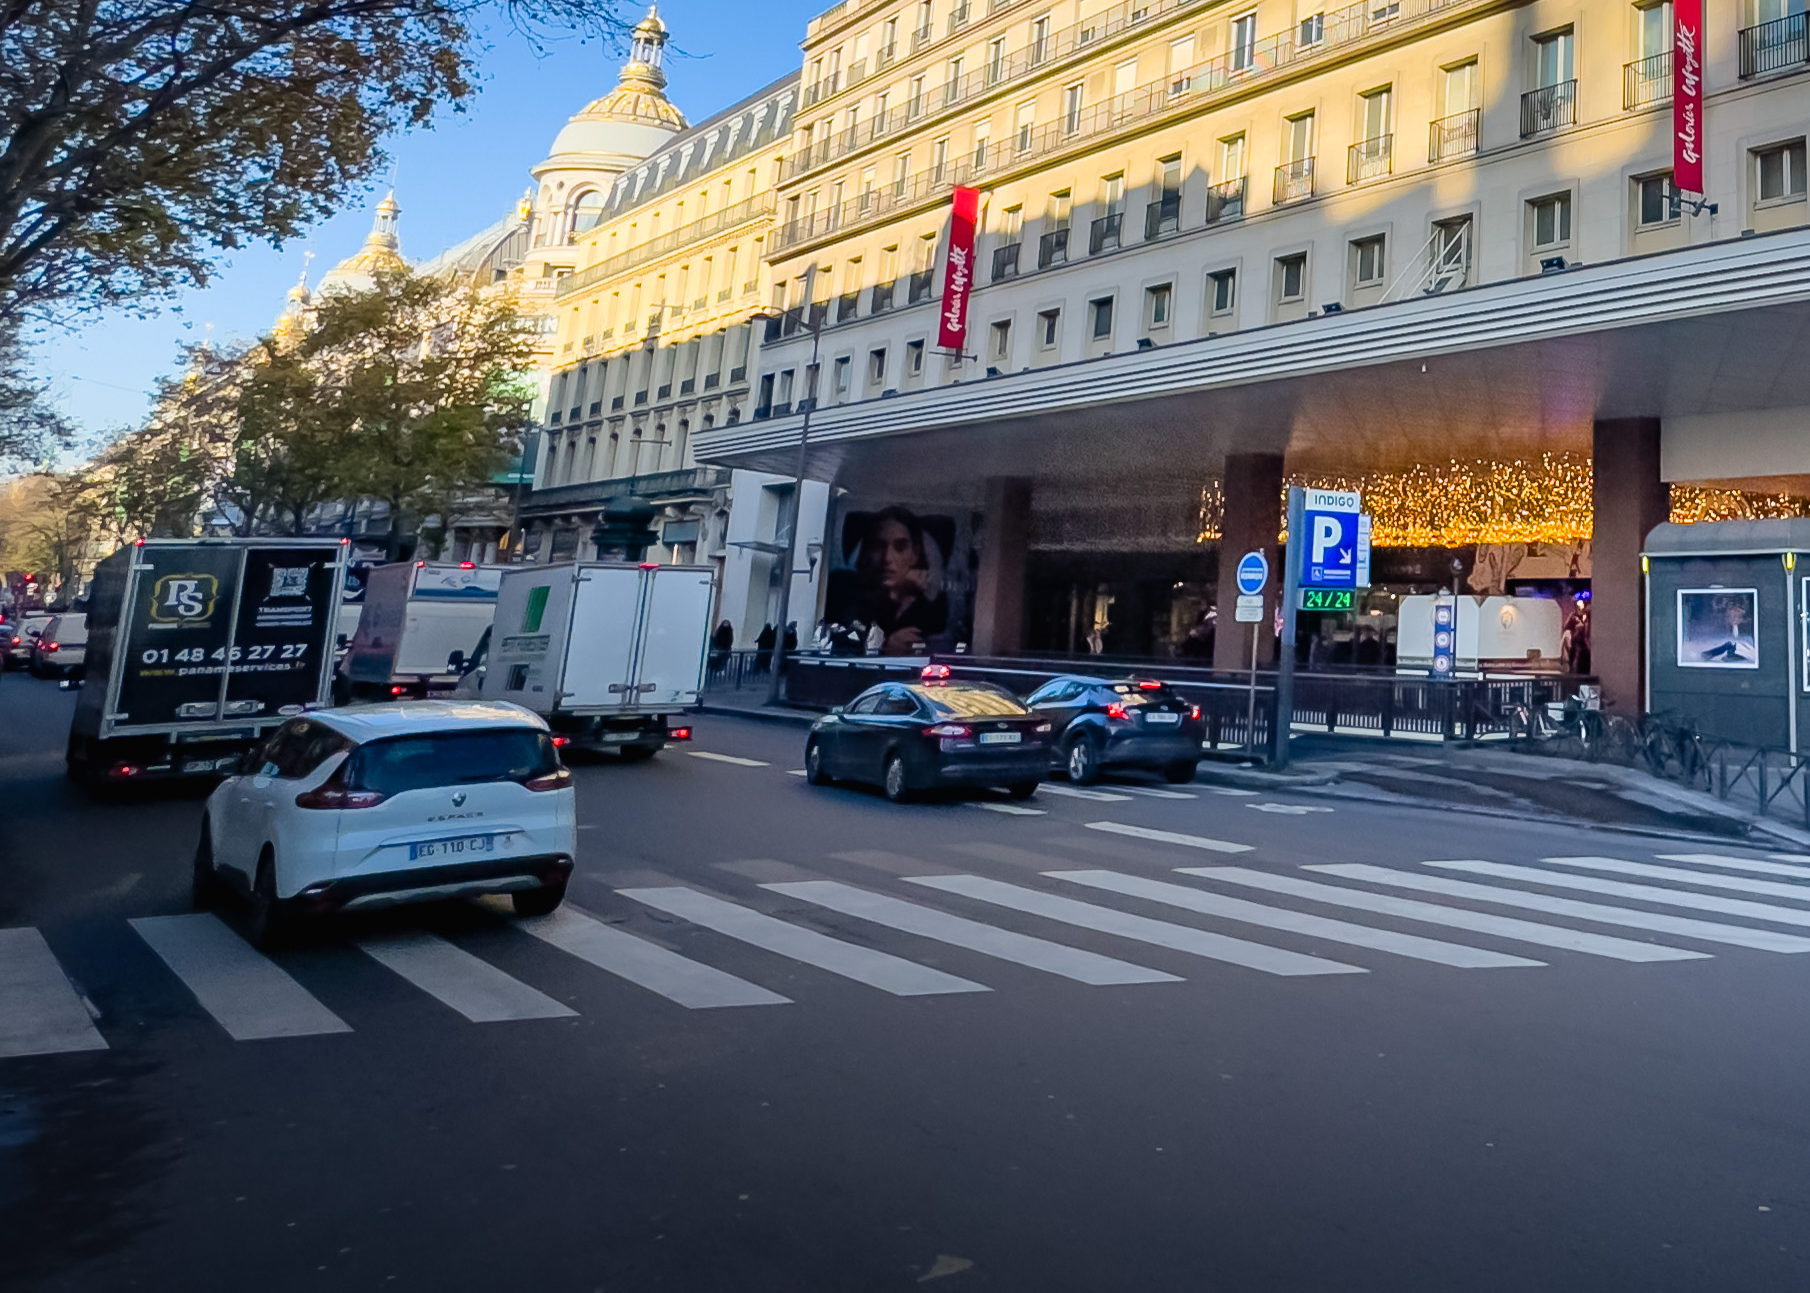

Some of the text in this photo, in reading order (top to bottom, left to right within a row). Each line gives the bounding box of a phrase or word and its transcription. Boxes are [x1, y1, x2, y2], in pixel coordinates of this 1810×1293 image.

[1315, 494, 1354, 507] INDIGO
[1312, 516, 1342, 563] P
[142, 643, 309, 664] 01 48 46 27 27
